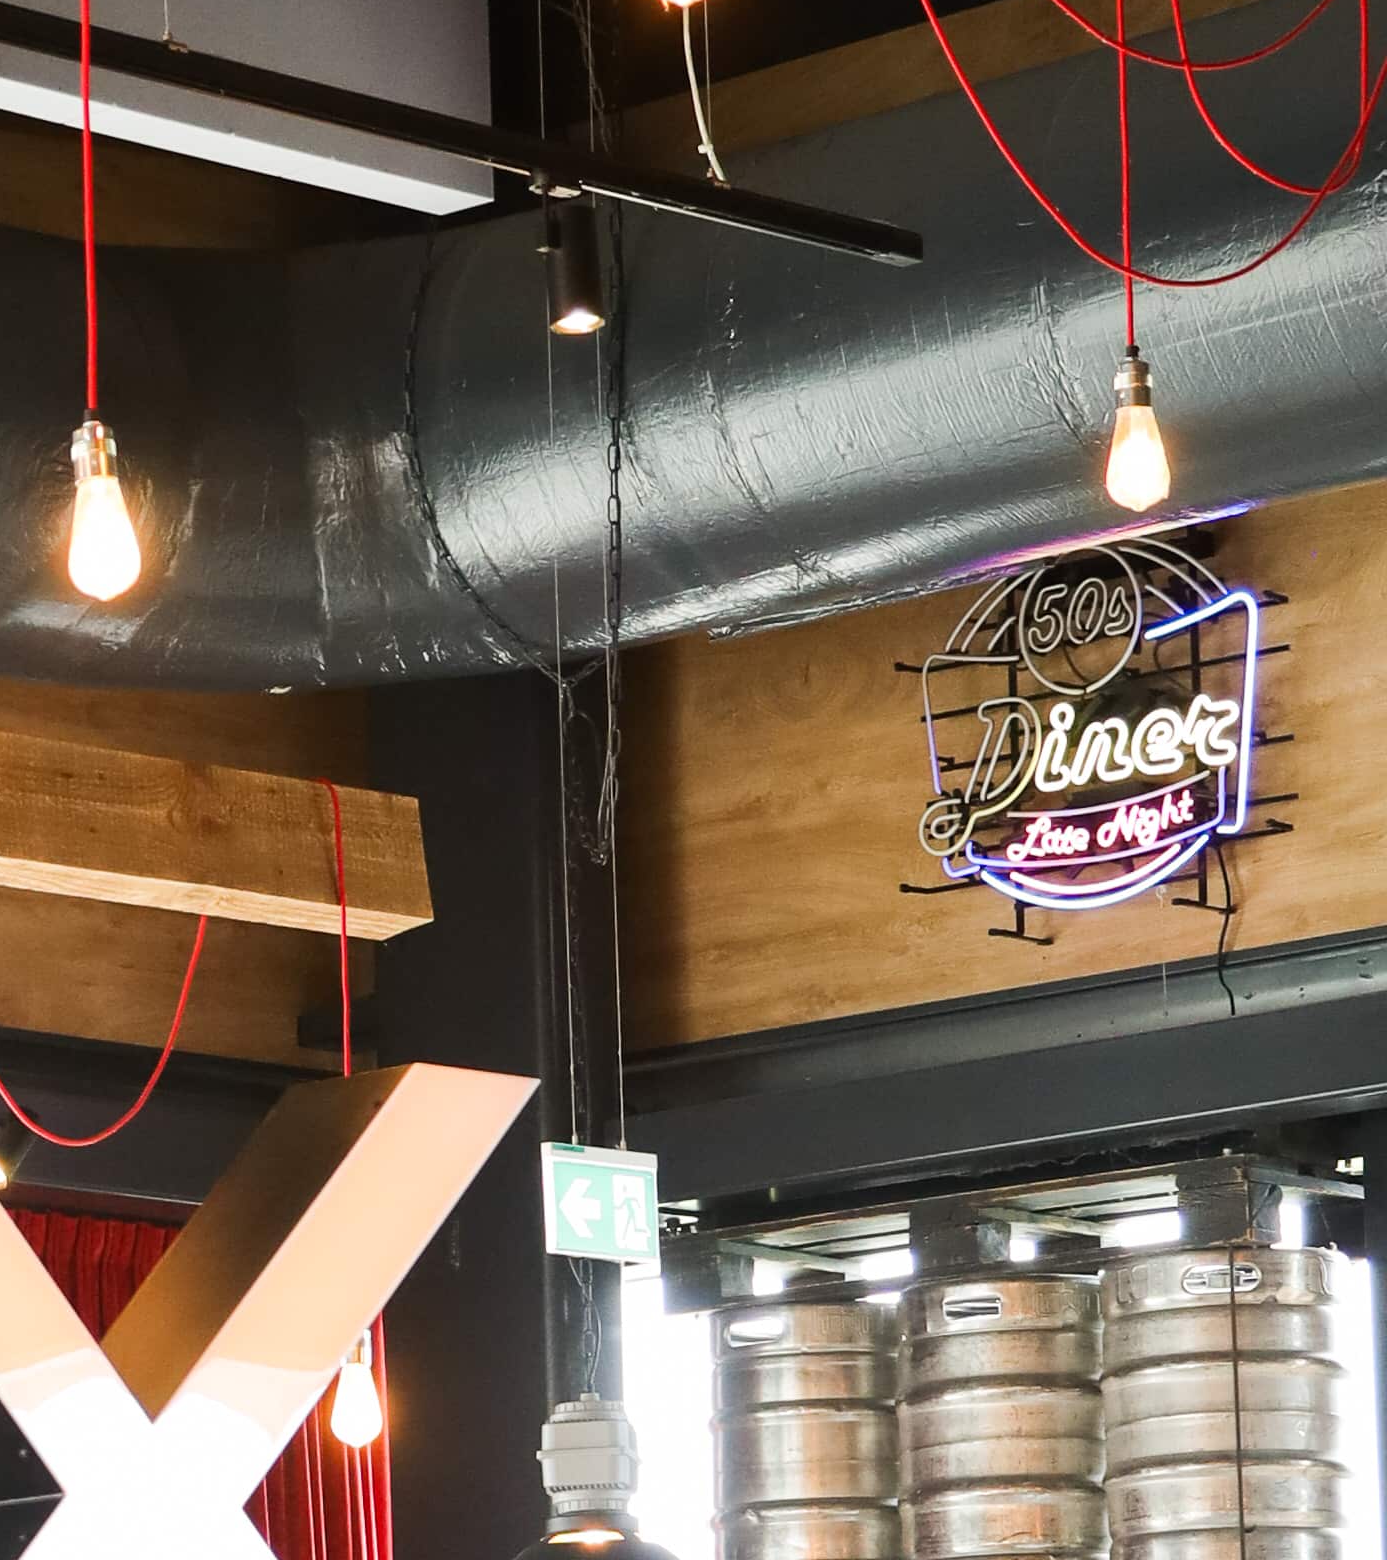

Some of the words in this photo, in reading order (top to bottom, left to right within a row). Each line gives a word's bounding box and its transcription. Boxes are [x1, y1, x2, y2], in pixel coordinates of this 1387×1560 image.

[918, 692, 1241, 857] Diner
[1006, 815, 1091, 862] Late
[1096, 789, 1195, 847] Night
